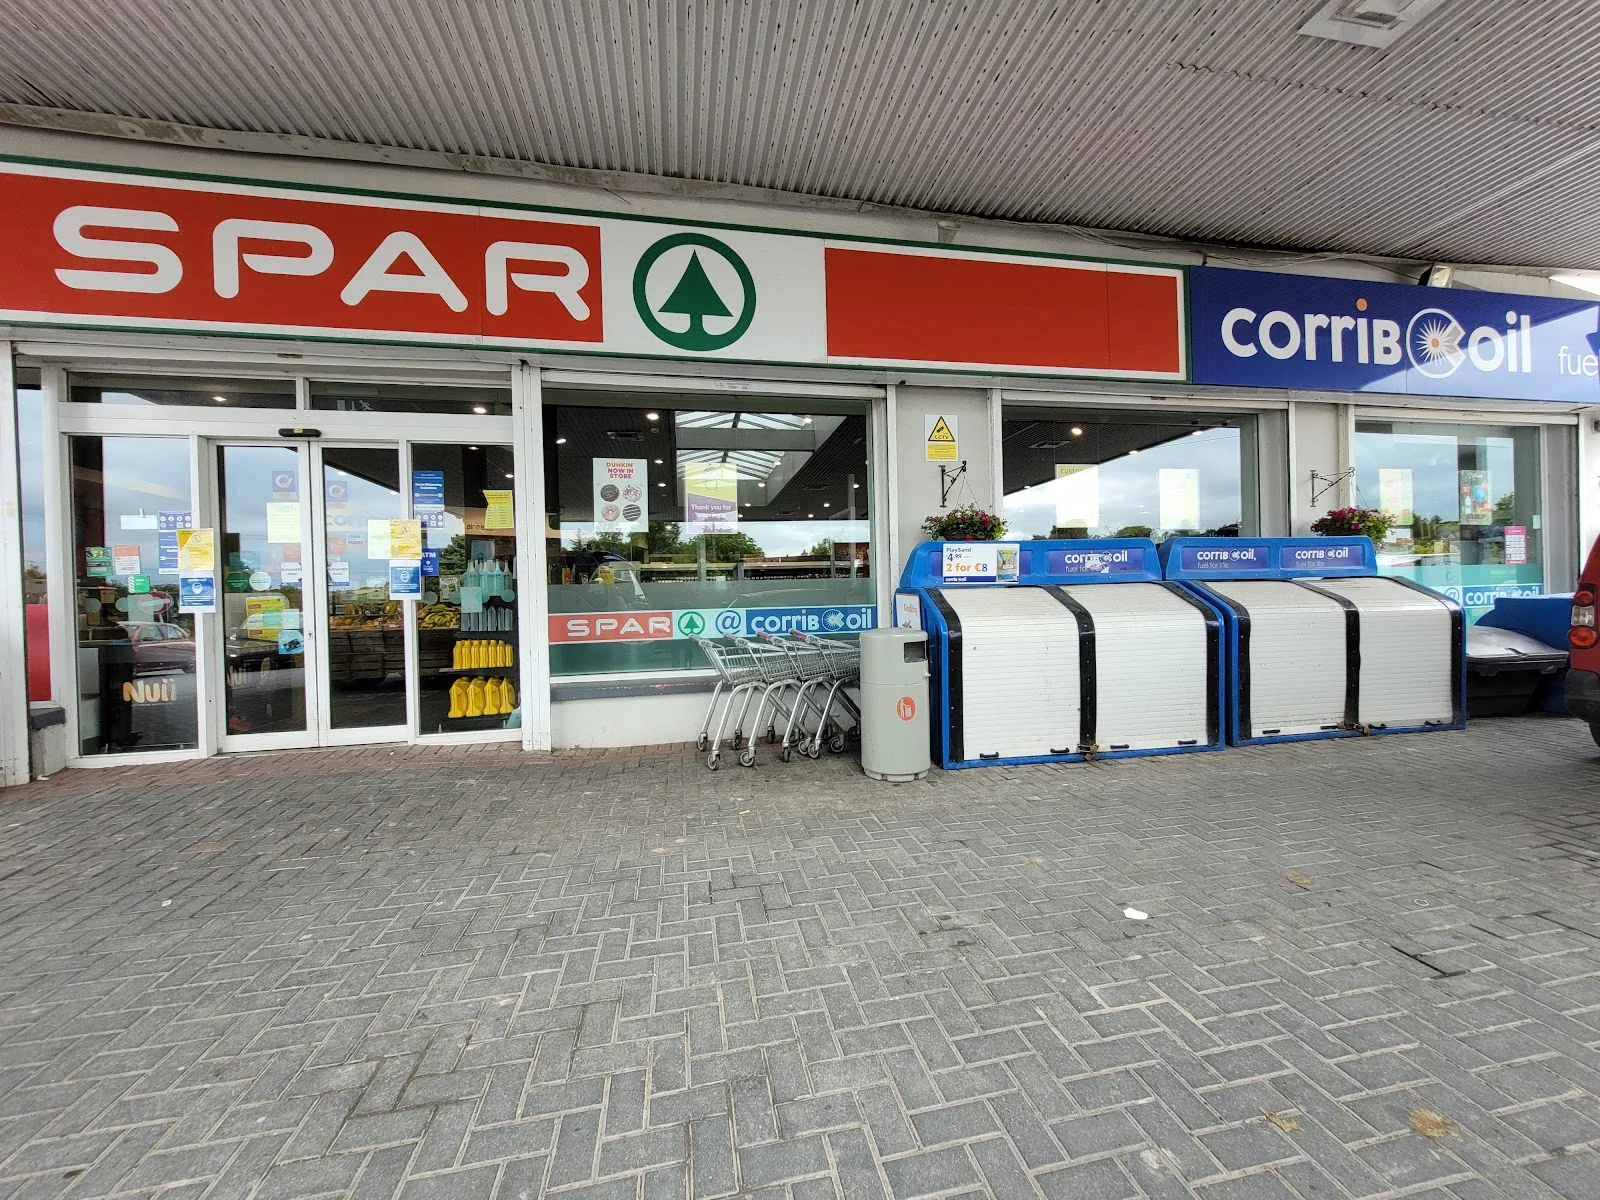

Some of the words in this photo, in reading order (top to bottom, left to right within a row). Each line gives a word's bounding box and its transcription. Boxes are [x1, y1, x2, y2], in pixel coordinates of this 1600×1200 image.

[52, 204, 591, 322] SPAR
[1467, 310, 1532, 373] oil
[1112, 549, 1128, 563] oil
[1335, 546, 1349, 559] oil
[945, 562, 953, 572] 2
[955, 562, 971, 572] for
[974, 562, 988, 572] €8
[566, 616, 672, 638] SPAR
[845, 607, 872, 630] oil
[122, 677, 178, 704] Nuii
